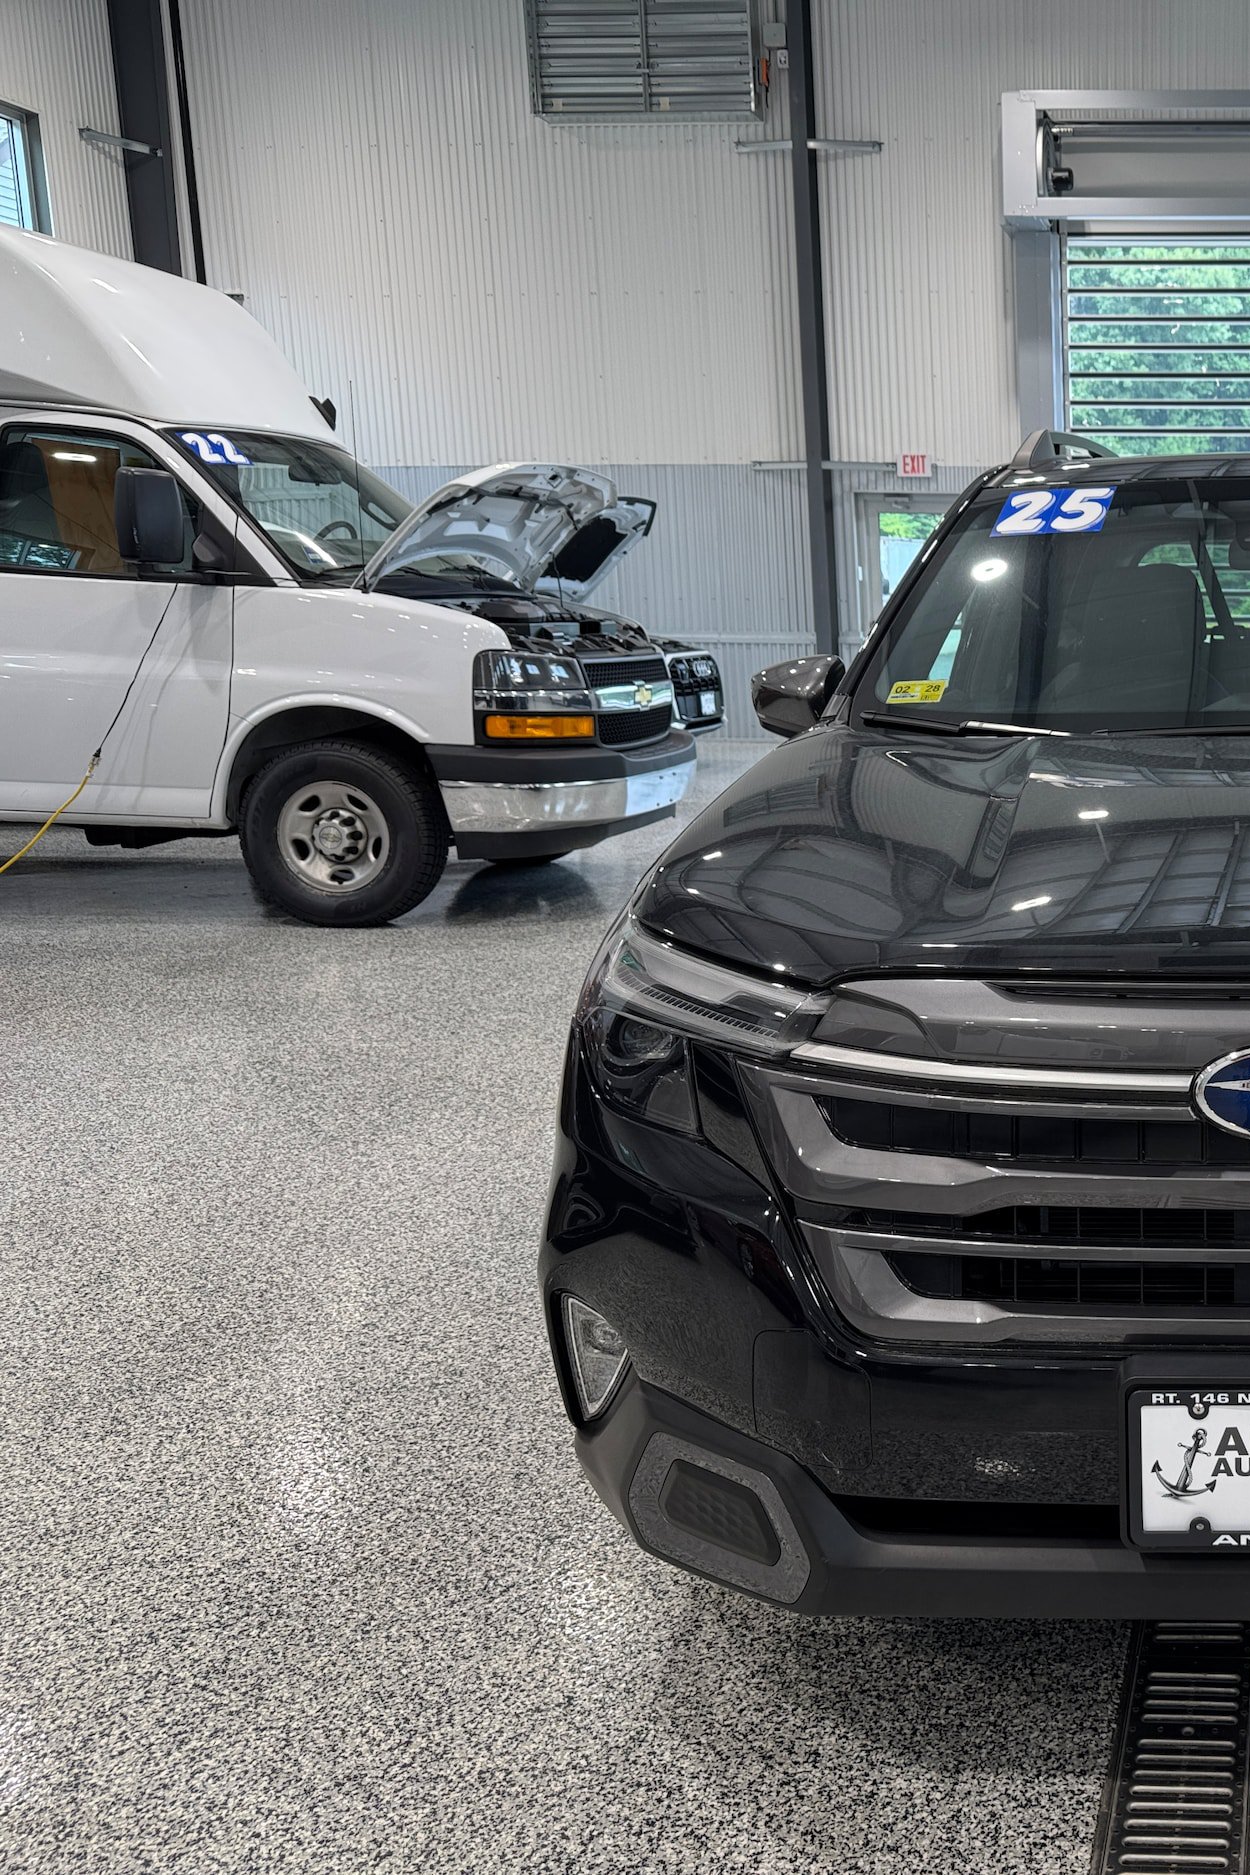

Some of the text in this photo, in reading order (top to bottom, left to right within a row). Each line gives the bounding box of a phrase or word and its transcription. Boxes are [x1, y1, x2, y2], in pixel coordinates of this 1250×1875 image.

[181, 433, 250, 464] 22
[902, 454, 926, 474] EXIT
[997, 488, 1115, 534] 25
[895, 684, 941, 693] 02 28
[1151, 1393, 1181, 1404] RT.
[1190, 1393, 1230, 1404] 146
